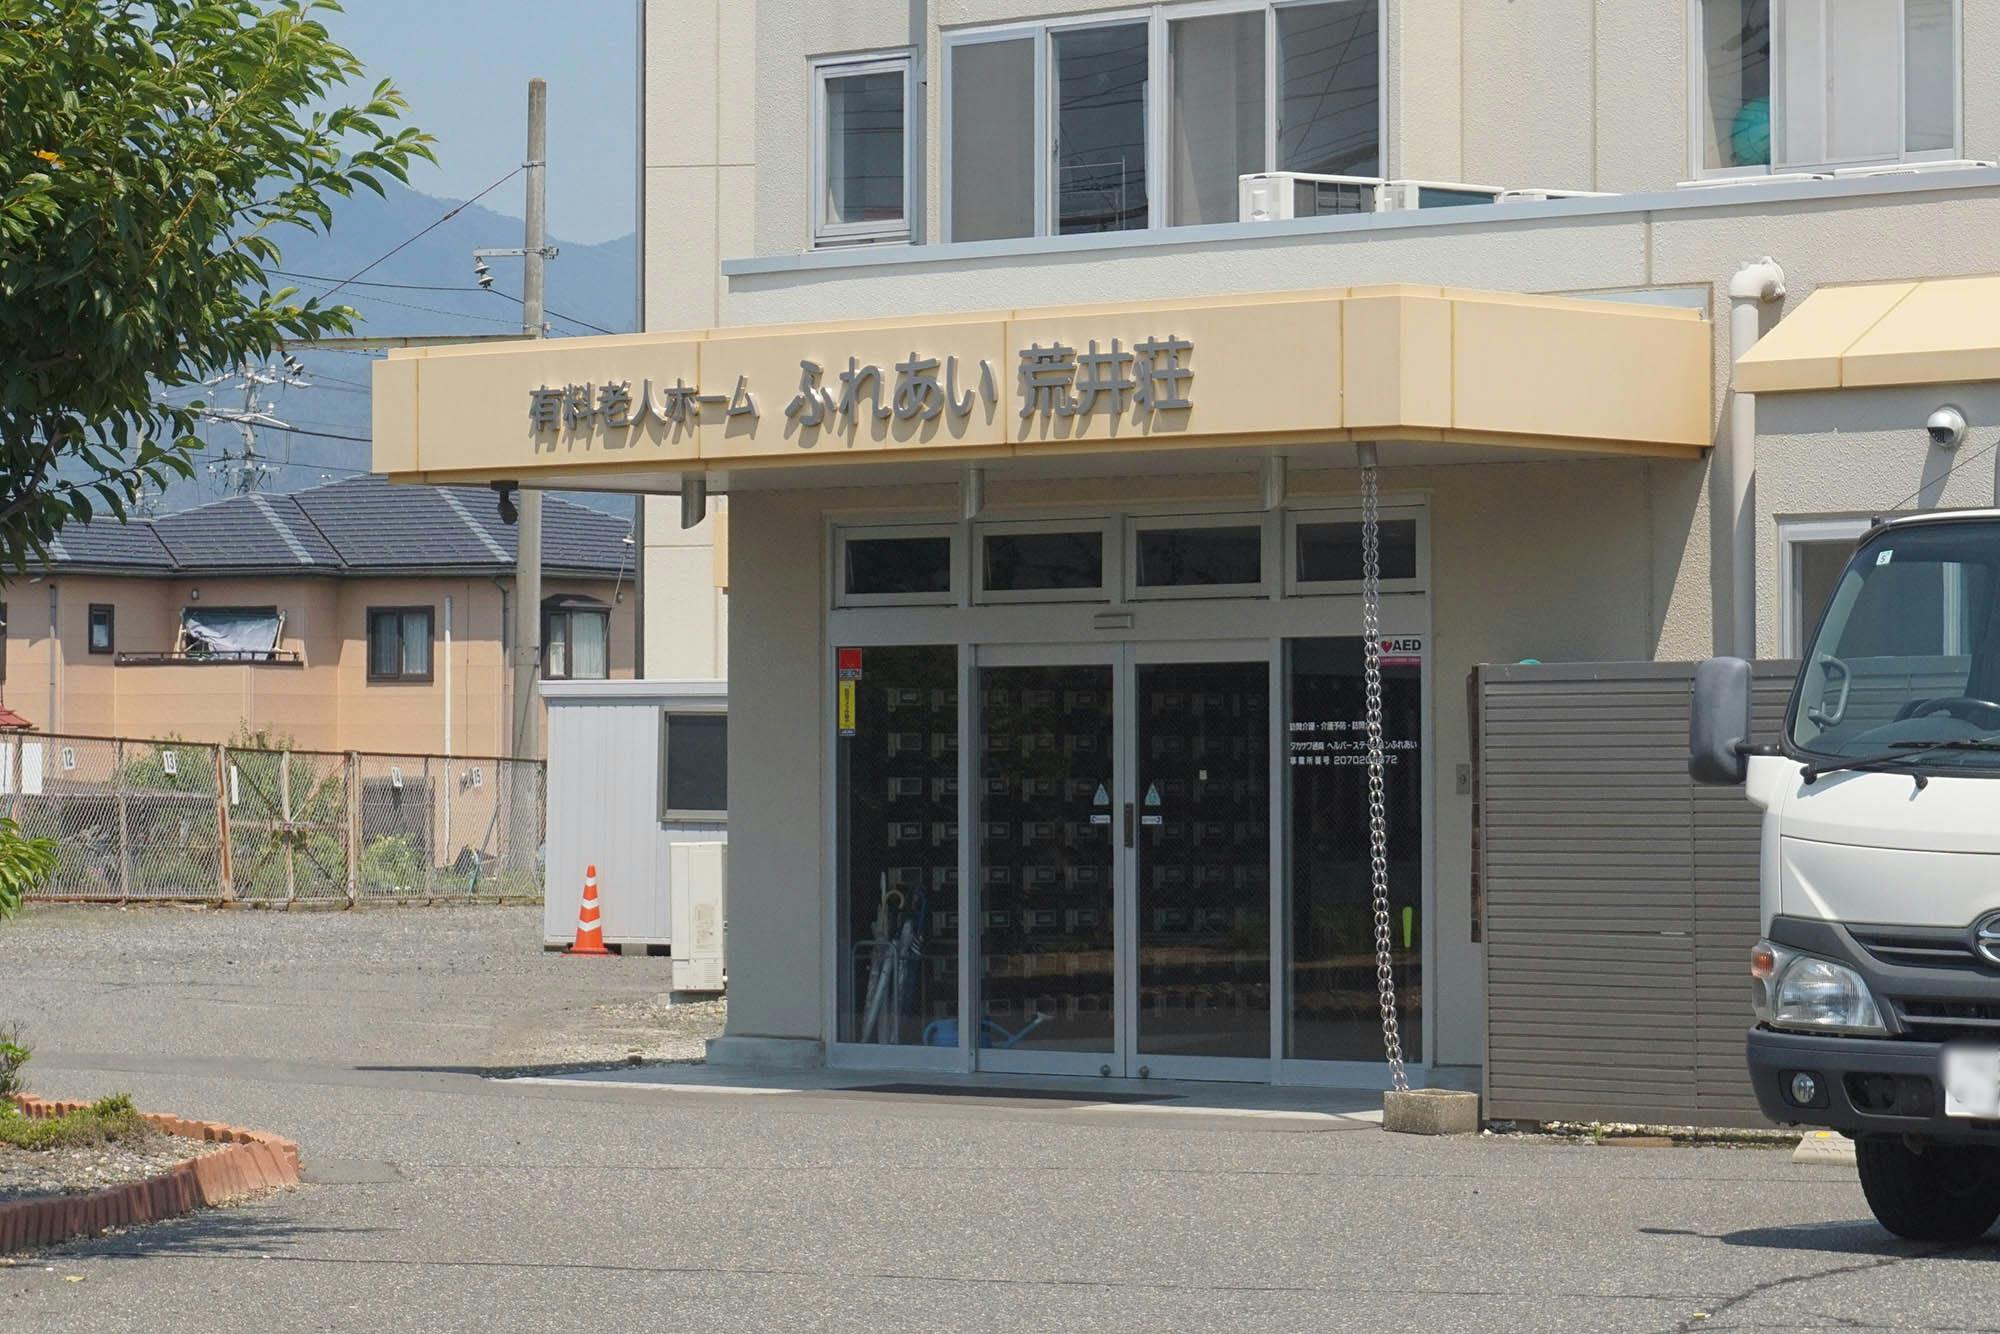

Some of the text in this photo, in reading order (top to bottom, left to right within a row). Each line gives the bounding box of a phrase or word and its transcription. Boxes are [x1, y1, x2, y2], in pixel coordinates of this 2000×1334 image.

[529, 374, 760, 432] 有料老人ホーム
[1392, 639, 1421, 651] AED
[1289, 721, 1378, 732] 訪問介護・介護予防・訪問
[64, 749, 73, 767] 12
[165, 753, 175, 770] 13
[1333, 755, 1398, 765] 20702072
